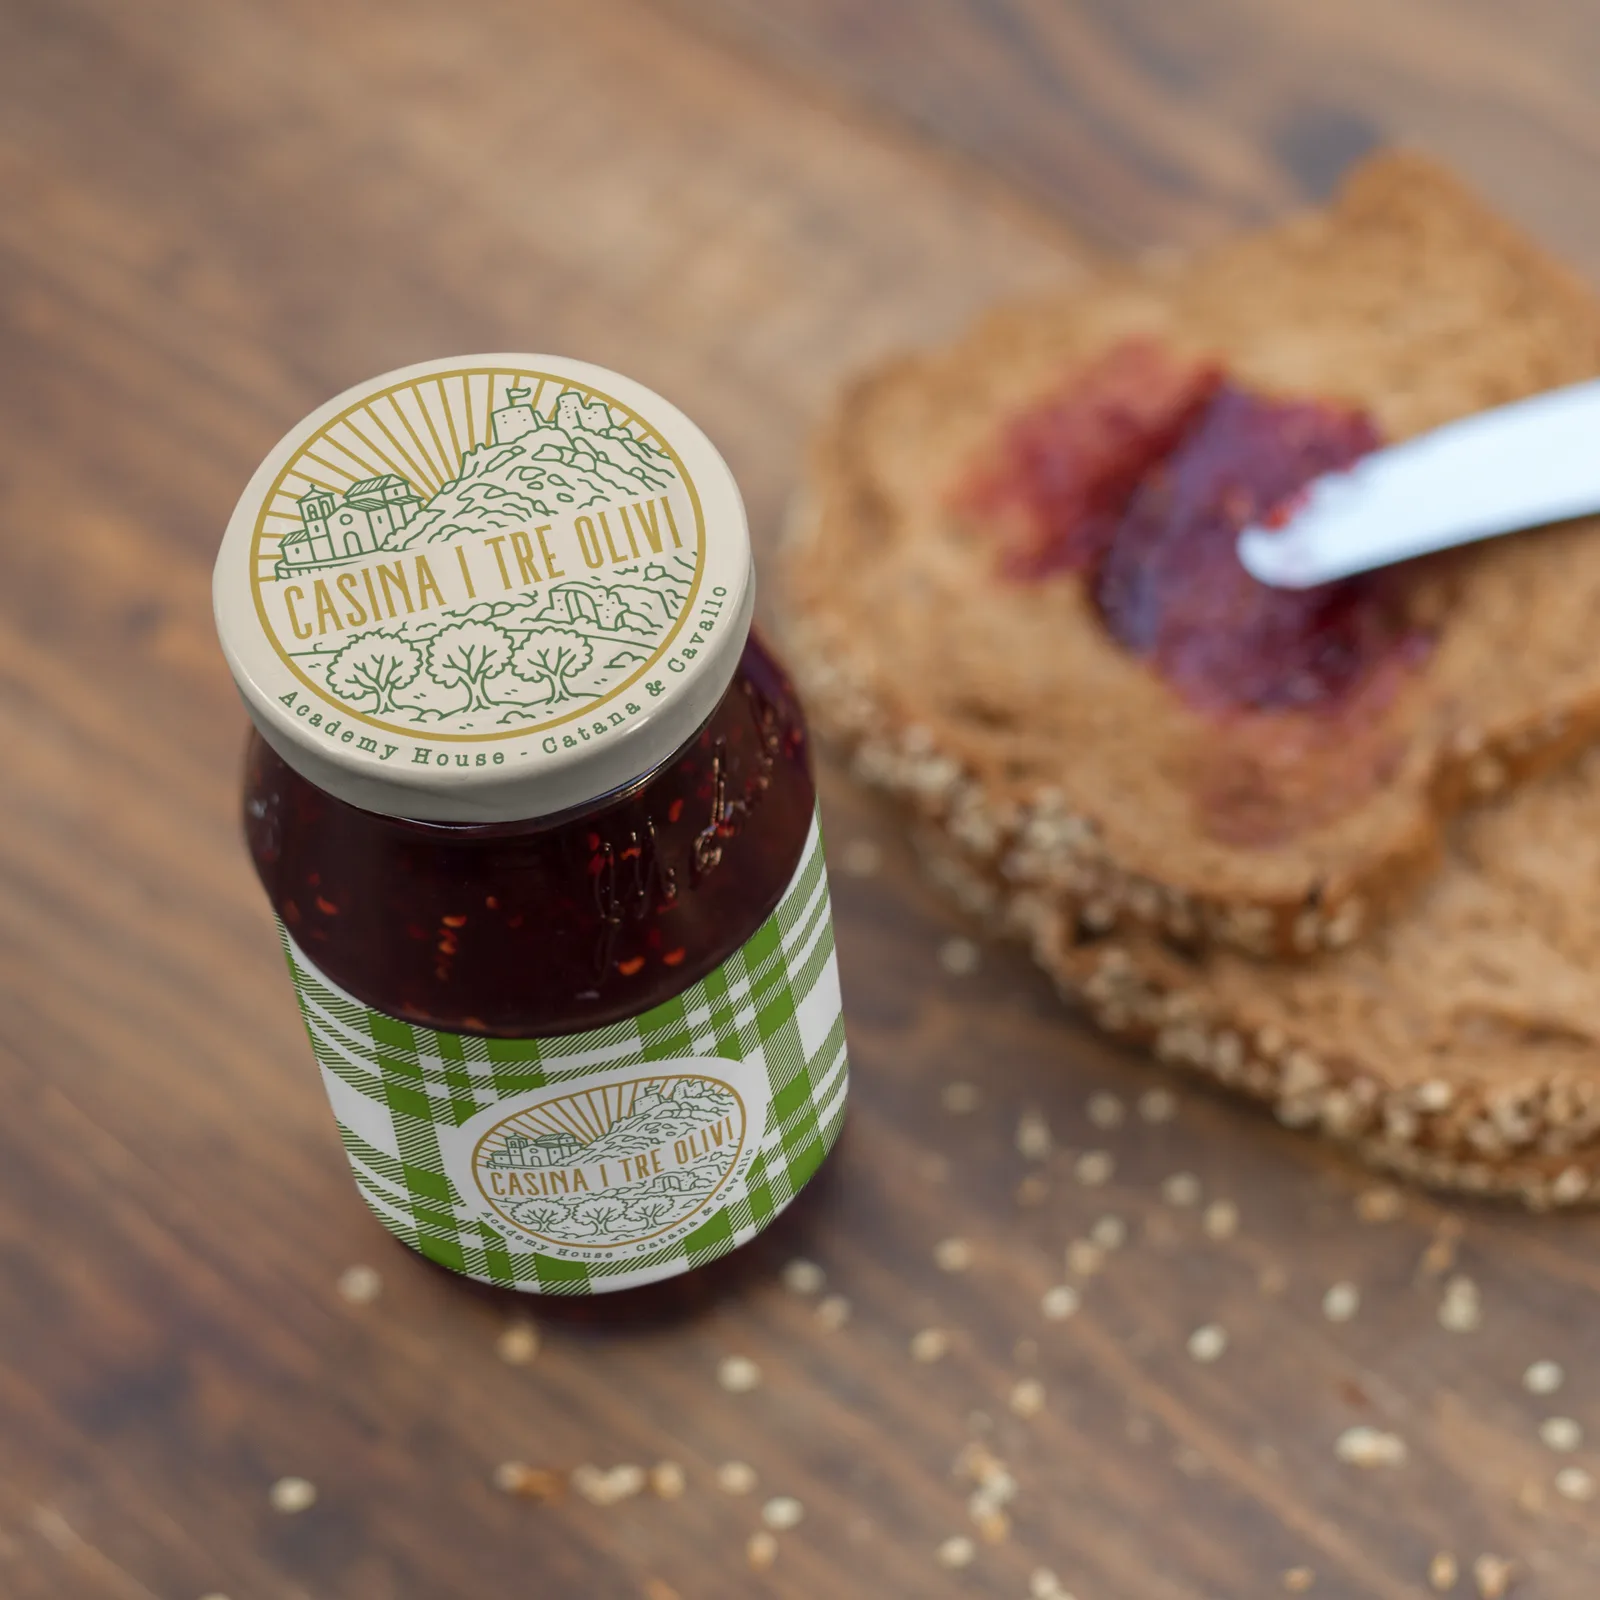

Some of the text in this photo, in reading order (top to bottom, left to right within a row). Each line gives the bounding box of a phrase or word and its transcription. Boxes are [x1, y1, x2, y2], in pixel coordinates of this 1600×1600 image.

[283, 495, 684, 640] CASINA I TRE OLIVI
[278, 690, 399, 761] Academy
[412, 746, 506, 768] House
[542, 701, 642, 755] Catana
[645, 680, 667, 697] &
[667, 585, 728, 675] Cavallo
[480, 1210, 550, 1251] Academy
[556, 1248, 614, 1259] House
[636, 1219, 698, 1252] Catana
[702, 1206, 714, 1216] &
[715, 1149, 753, 1201] Cavallo
[490, 1115, 734, 1197] CASINA I TRE OLIVI
